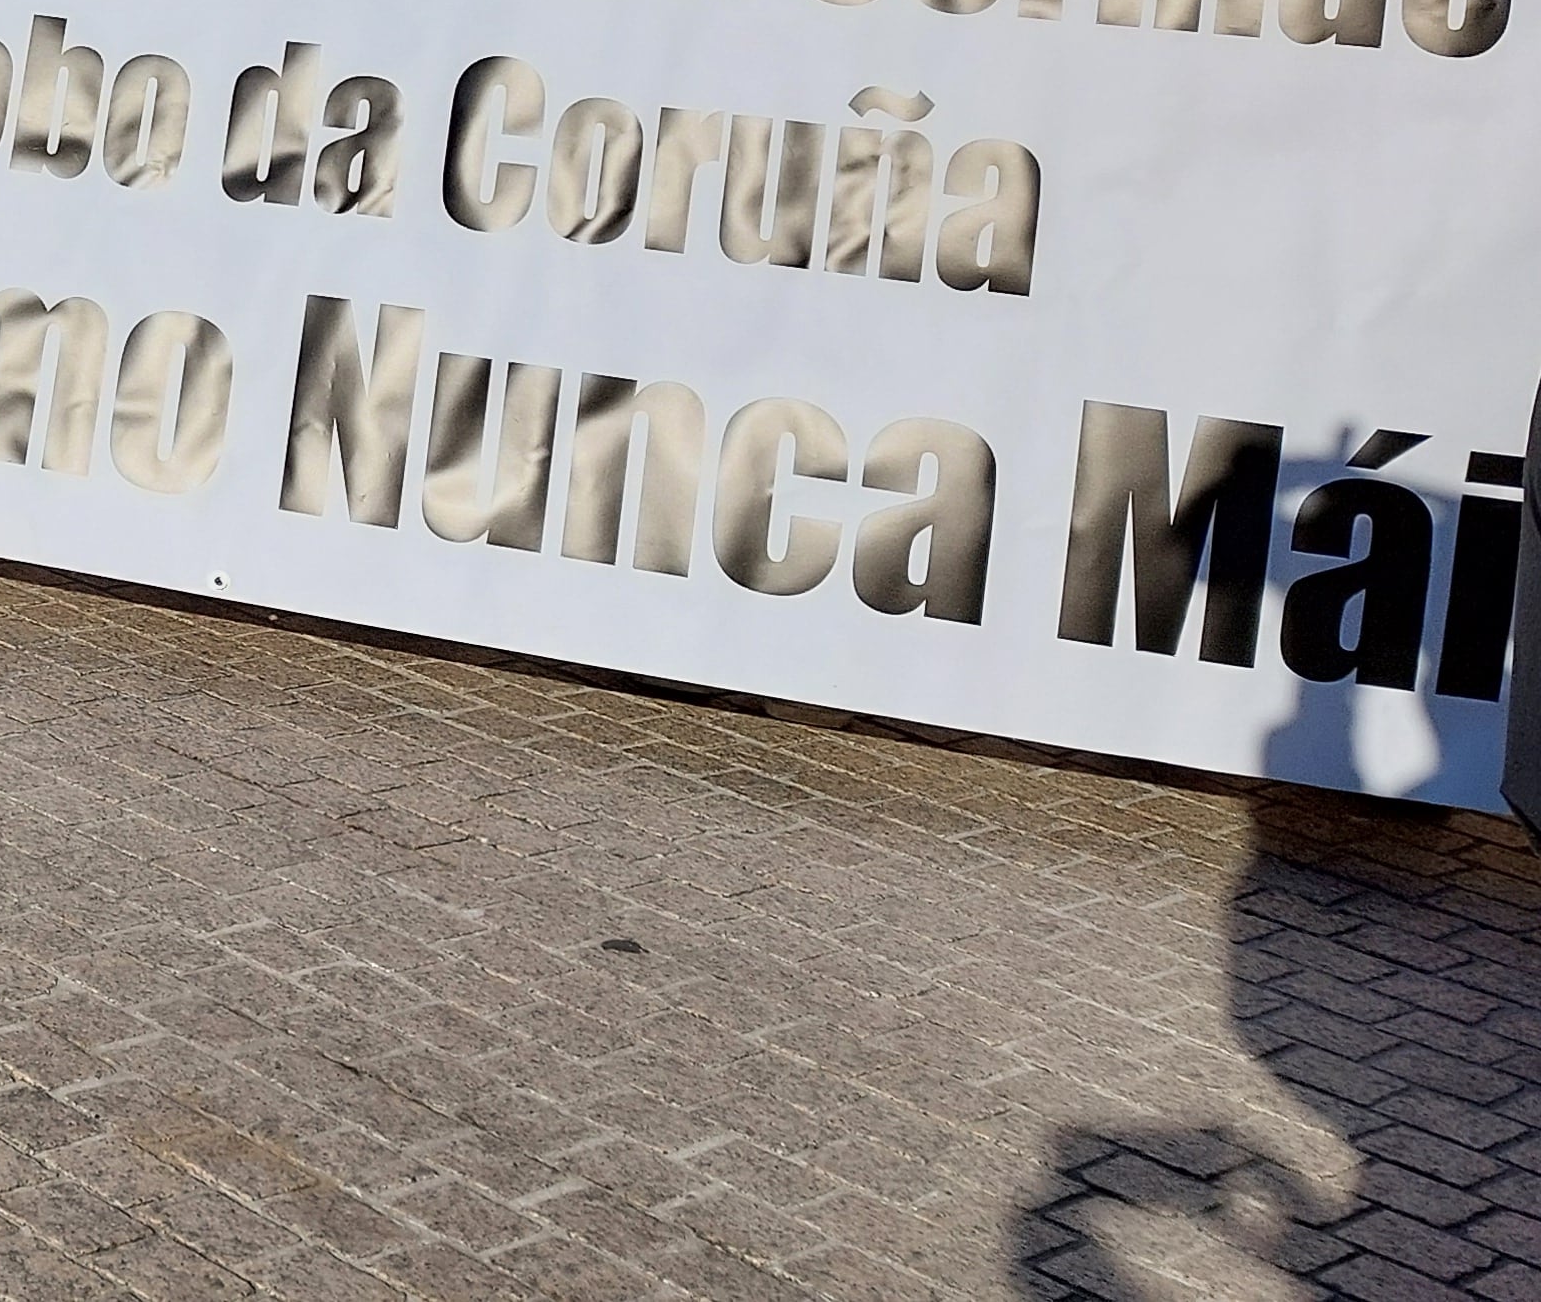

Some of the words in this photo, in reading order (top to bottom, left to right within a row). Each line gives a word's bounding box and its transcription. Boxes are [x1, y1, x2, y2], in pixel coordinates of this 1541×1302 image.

[220, 41, 406, 219] da
[440, 54, 1045, 298] Coruña
[278, 294, 999, 627] Nunca
